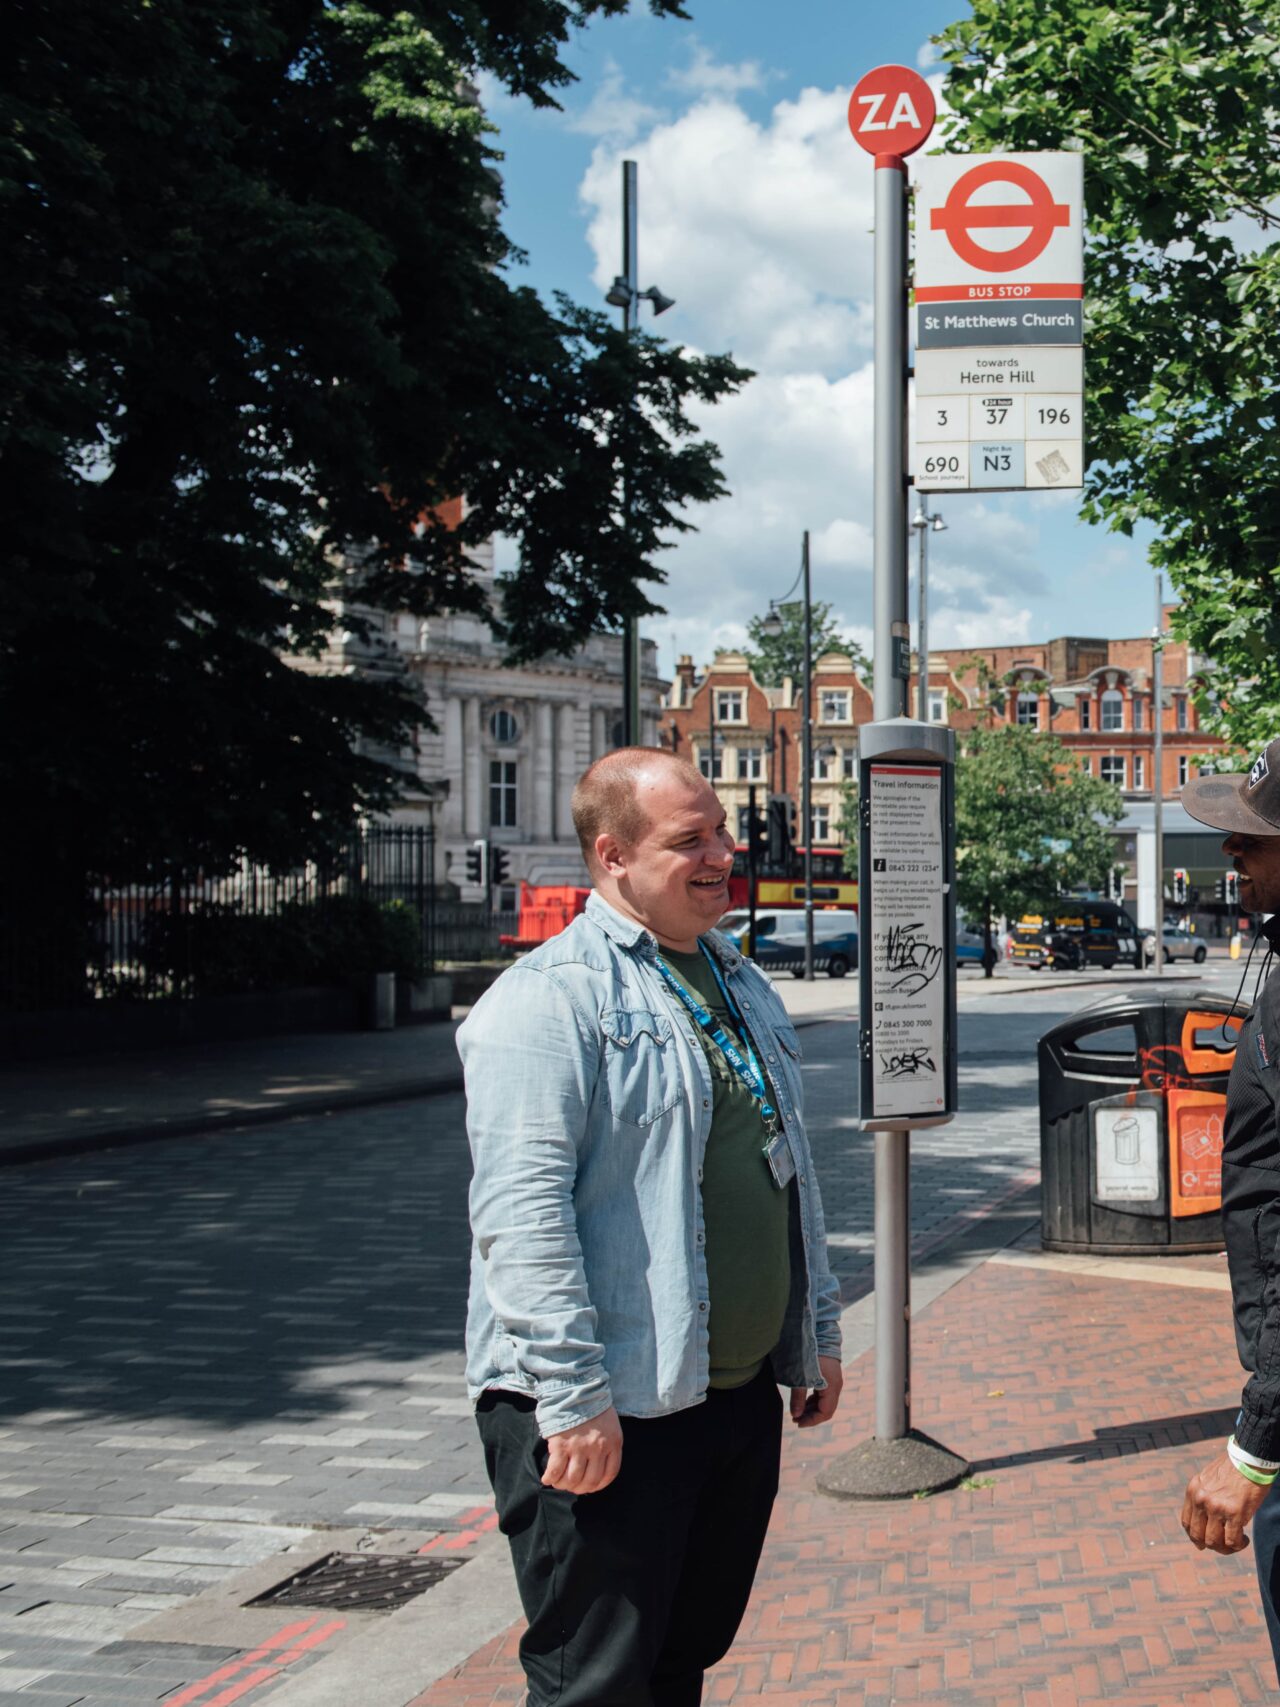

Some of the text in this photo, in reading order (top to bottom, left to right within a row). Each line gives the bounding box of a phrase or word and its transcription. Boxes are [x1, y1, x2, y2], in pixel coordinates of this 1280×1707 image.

[858, 92, 921, 132] ZA
[968, 286, 1031, 297] BUS STOP
[925, 312, 1075, 330] St Matthews Church
[976, 358, 1019, 368] towards
[960, 370, 1035, 384] Herne Hill
[937, 410, 948, 426] 3
[986, 408, 1008, 425] 37
[1038, 408, 1070, 425] 196
[925, 456, 959, 473] 690
[984, 454, 1011, 472] N3
[873, 780, 938, 789] Travel information
[725, 1048, 743, 1067] NHS
[741, 1070, 758, 1089] NHS
